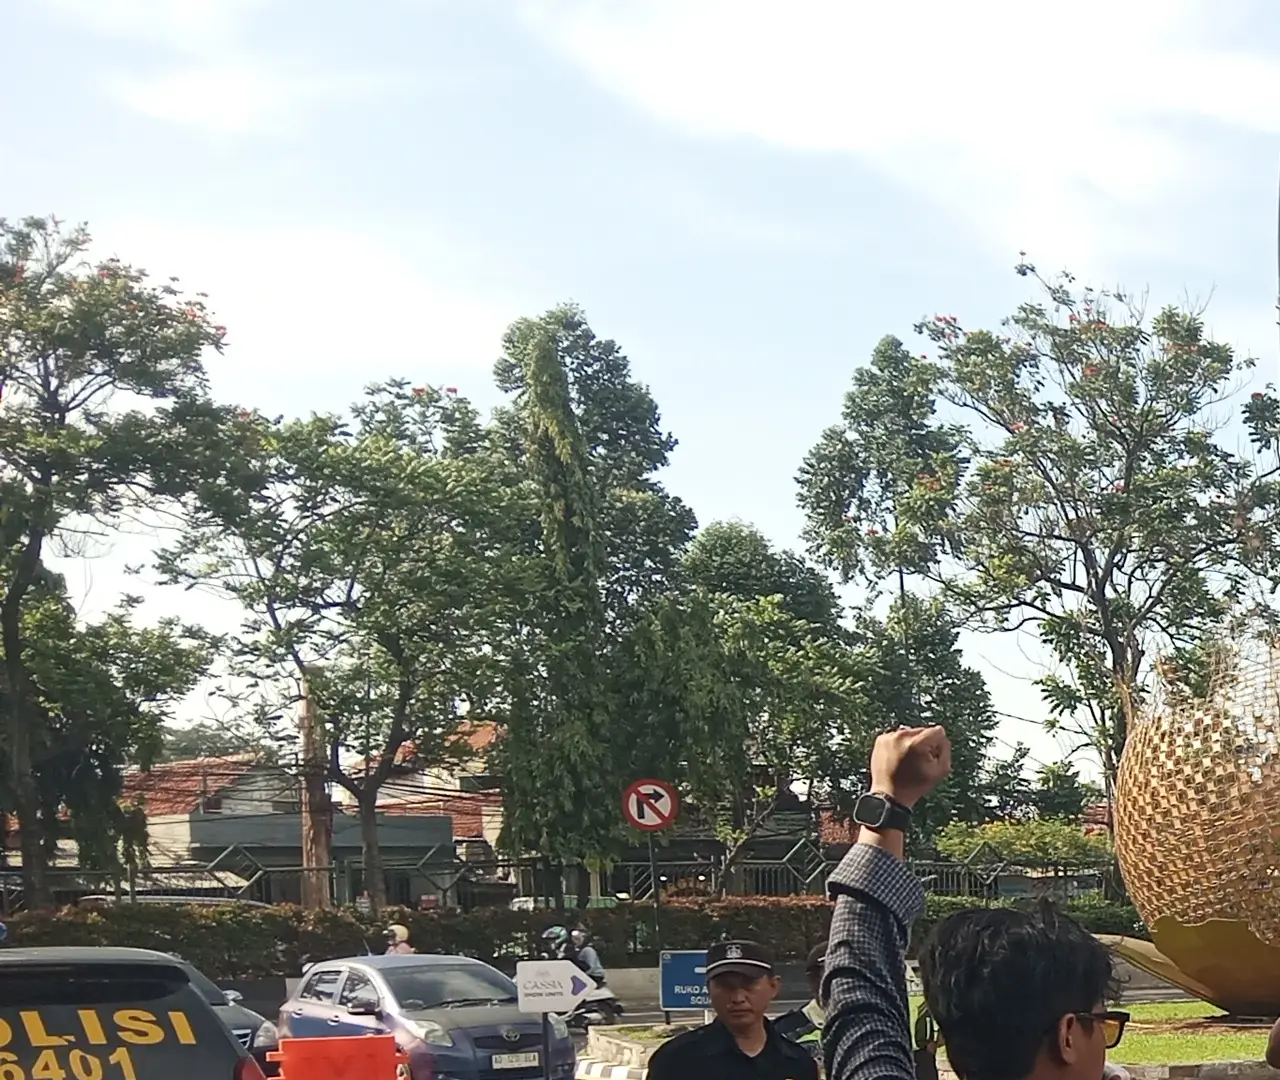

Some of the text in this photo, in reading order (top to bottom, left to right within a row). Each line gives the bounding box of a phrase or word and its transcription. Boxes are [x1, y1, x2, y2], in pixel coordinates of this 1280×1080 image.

[674, 985, 700, 994] RUKO
[690, 996, 712, 1005] SQU
[0, 1009, 197, 1047] LISI
